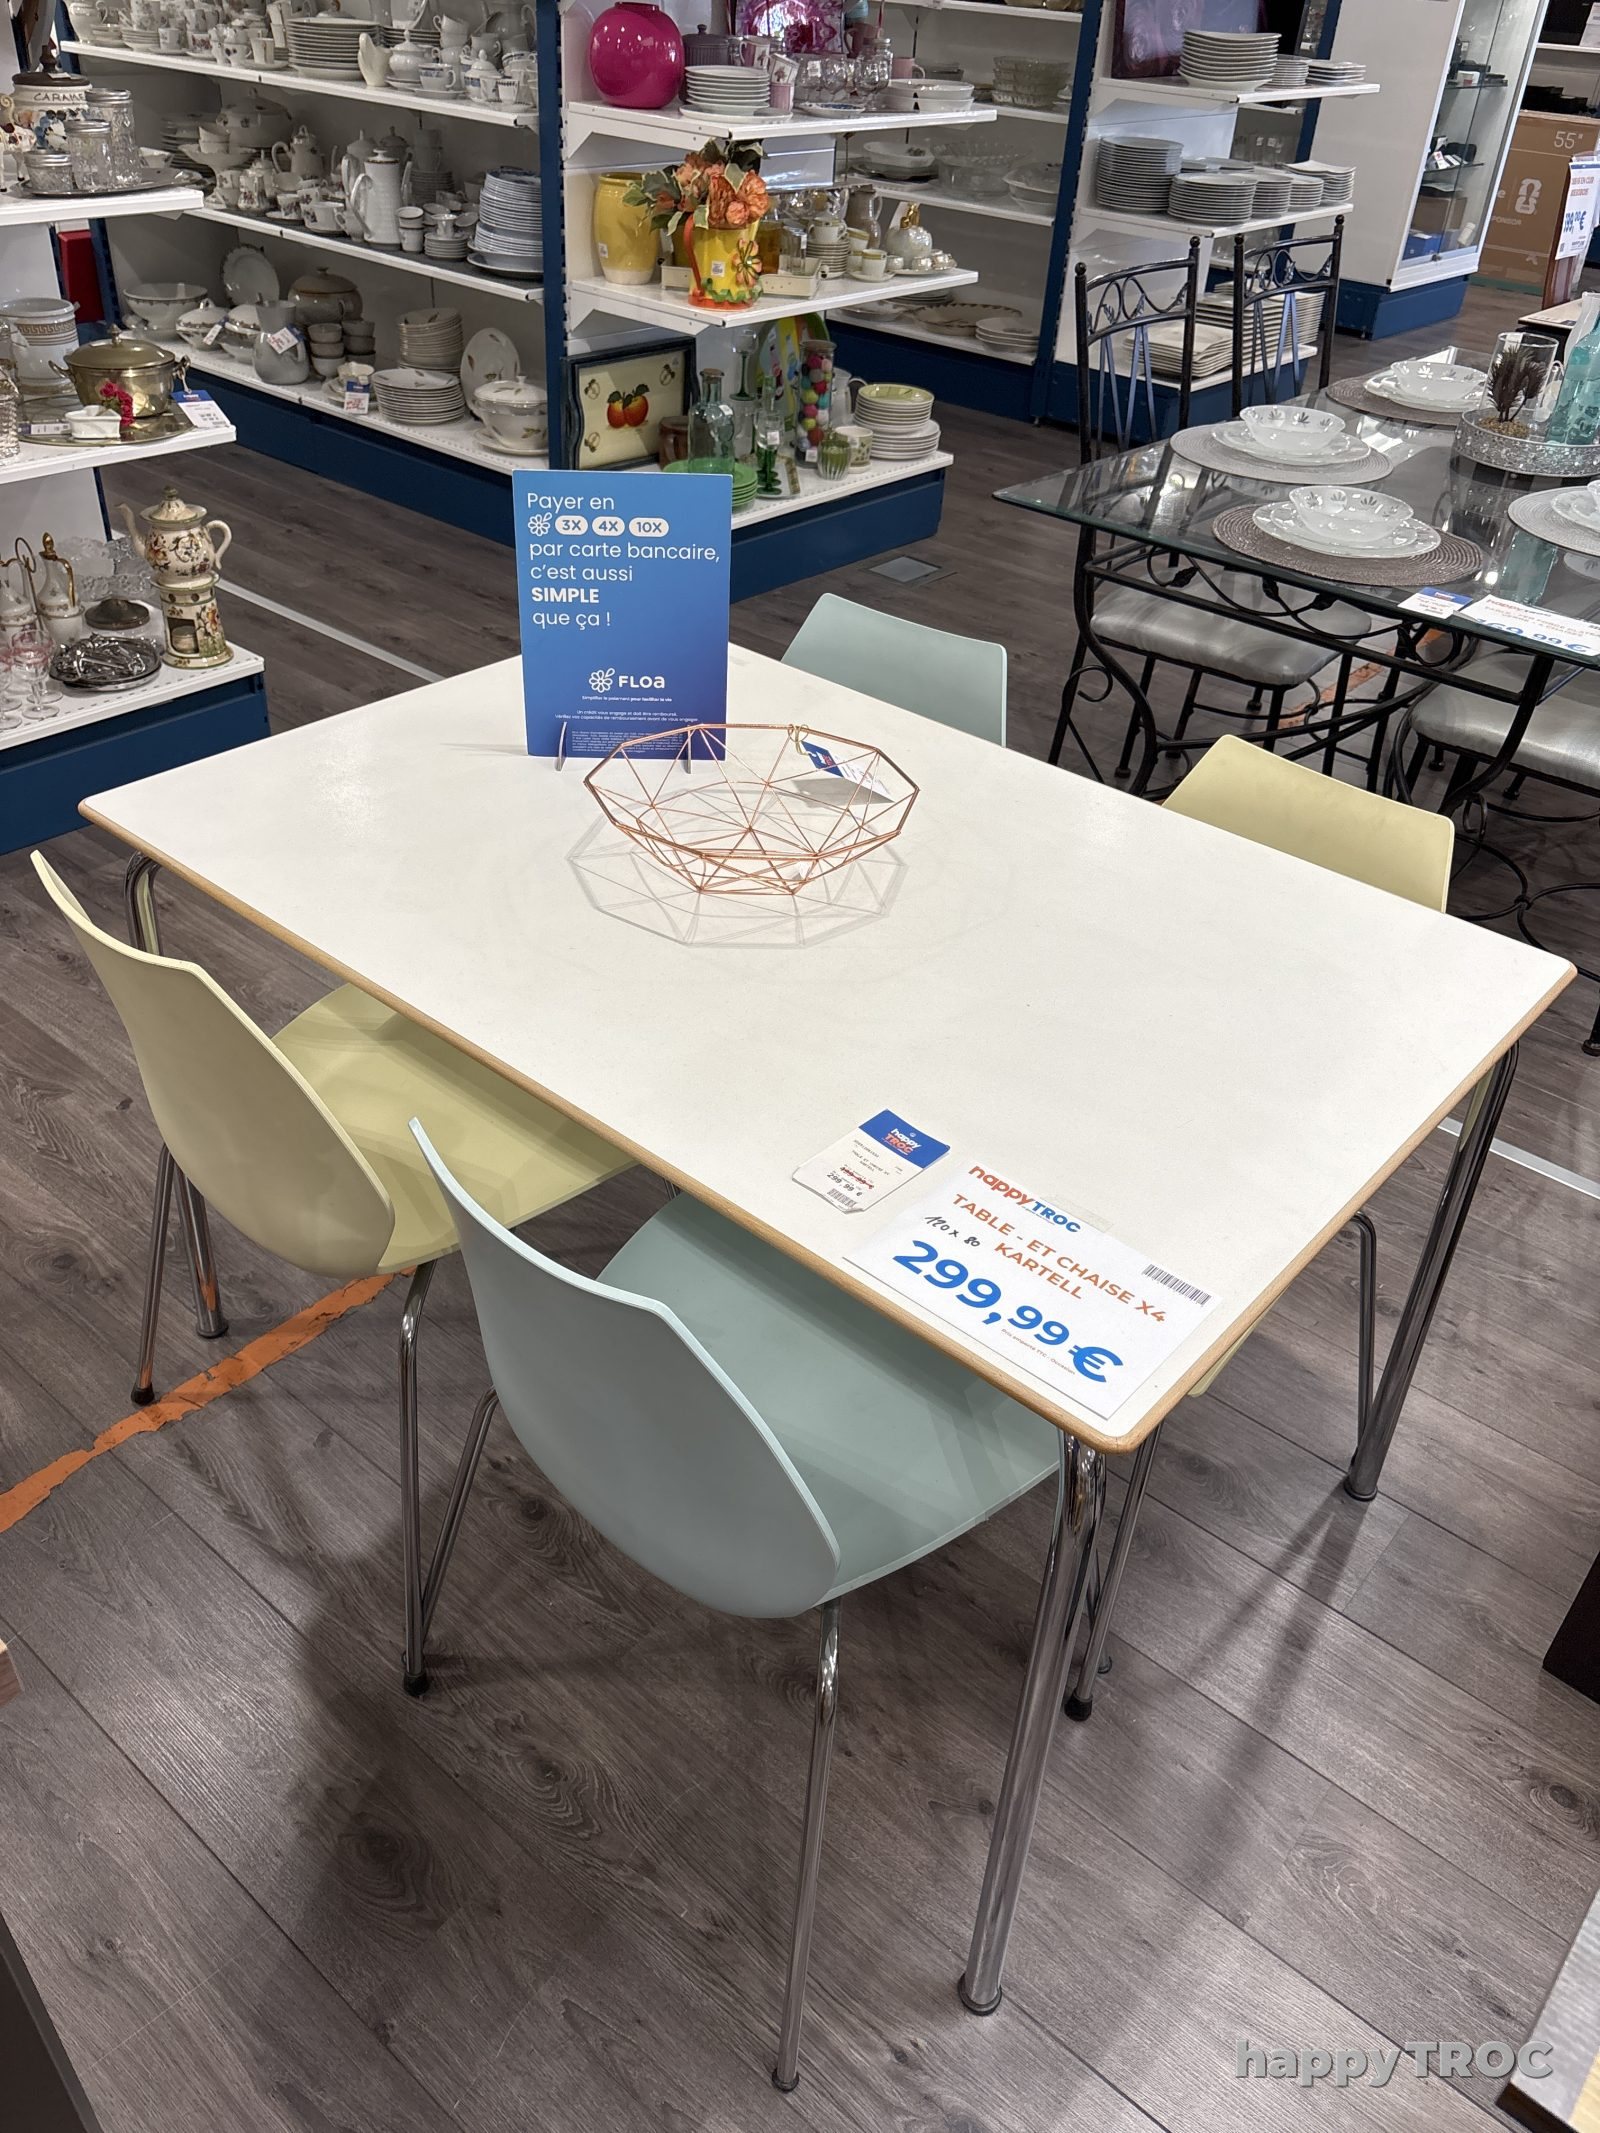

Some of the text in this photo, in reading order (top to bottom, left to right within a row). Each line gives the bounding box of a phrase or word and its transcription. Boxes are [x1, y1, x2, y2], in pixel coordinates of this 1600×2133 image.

[34, 92, 85, 102] CARAME
[1553, 130, 1583, 149] 55"
[1491, 215, 1522, 226] PONSOR
[527, 492, 615, 514] Payer en
[561, 519, 663, 533] 3X 4X 10X
[529, 542, 721, 563] par carte bancaire,
[582, 566, 634, 582] aussi
[531, 587, 600, 604] SIMPLE
[532, 611, 612, 630] que ça !
[884, 1132, 915, 1154] TROC
[891, 1128, 922, 1150] happy
[963, 1236, 981, 1247] 80
[953, 1193, 1016, 1236] TABLE
[1026, 1239, 1057, 1258] ET
[1056, 1256, 1136, 1304] CHAISE
[1134, 1300, 1167, 1322] X4
[994, 1242, 1083, 1300] KARTELL
[892, 1240, 1124, 1383] 299,99€
